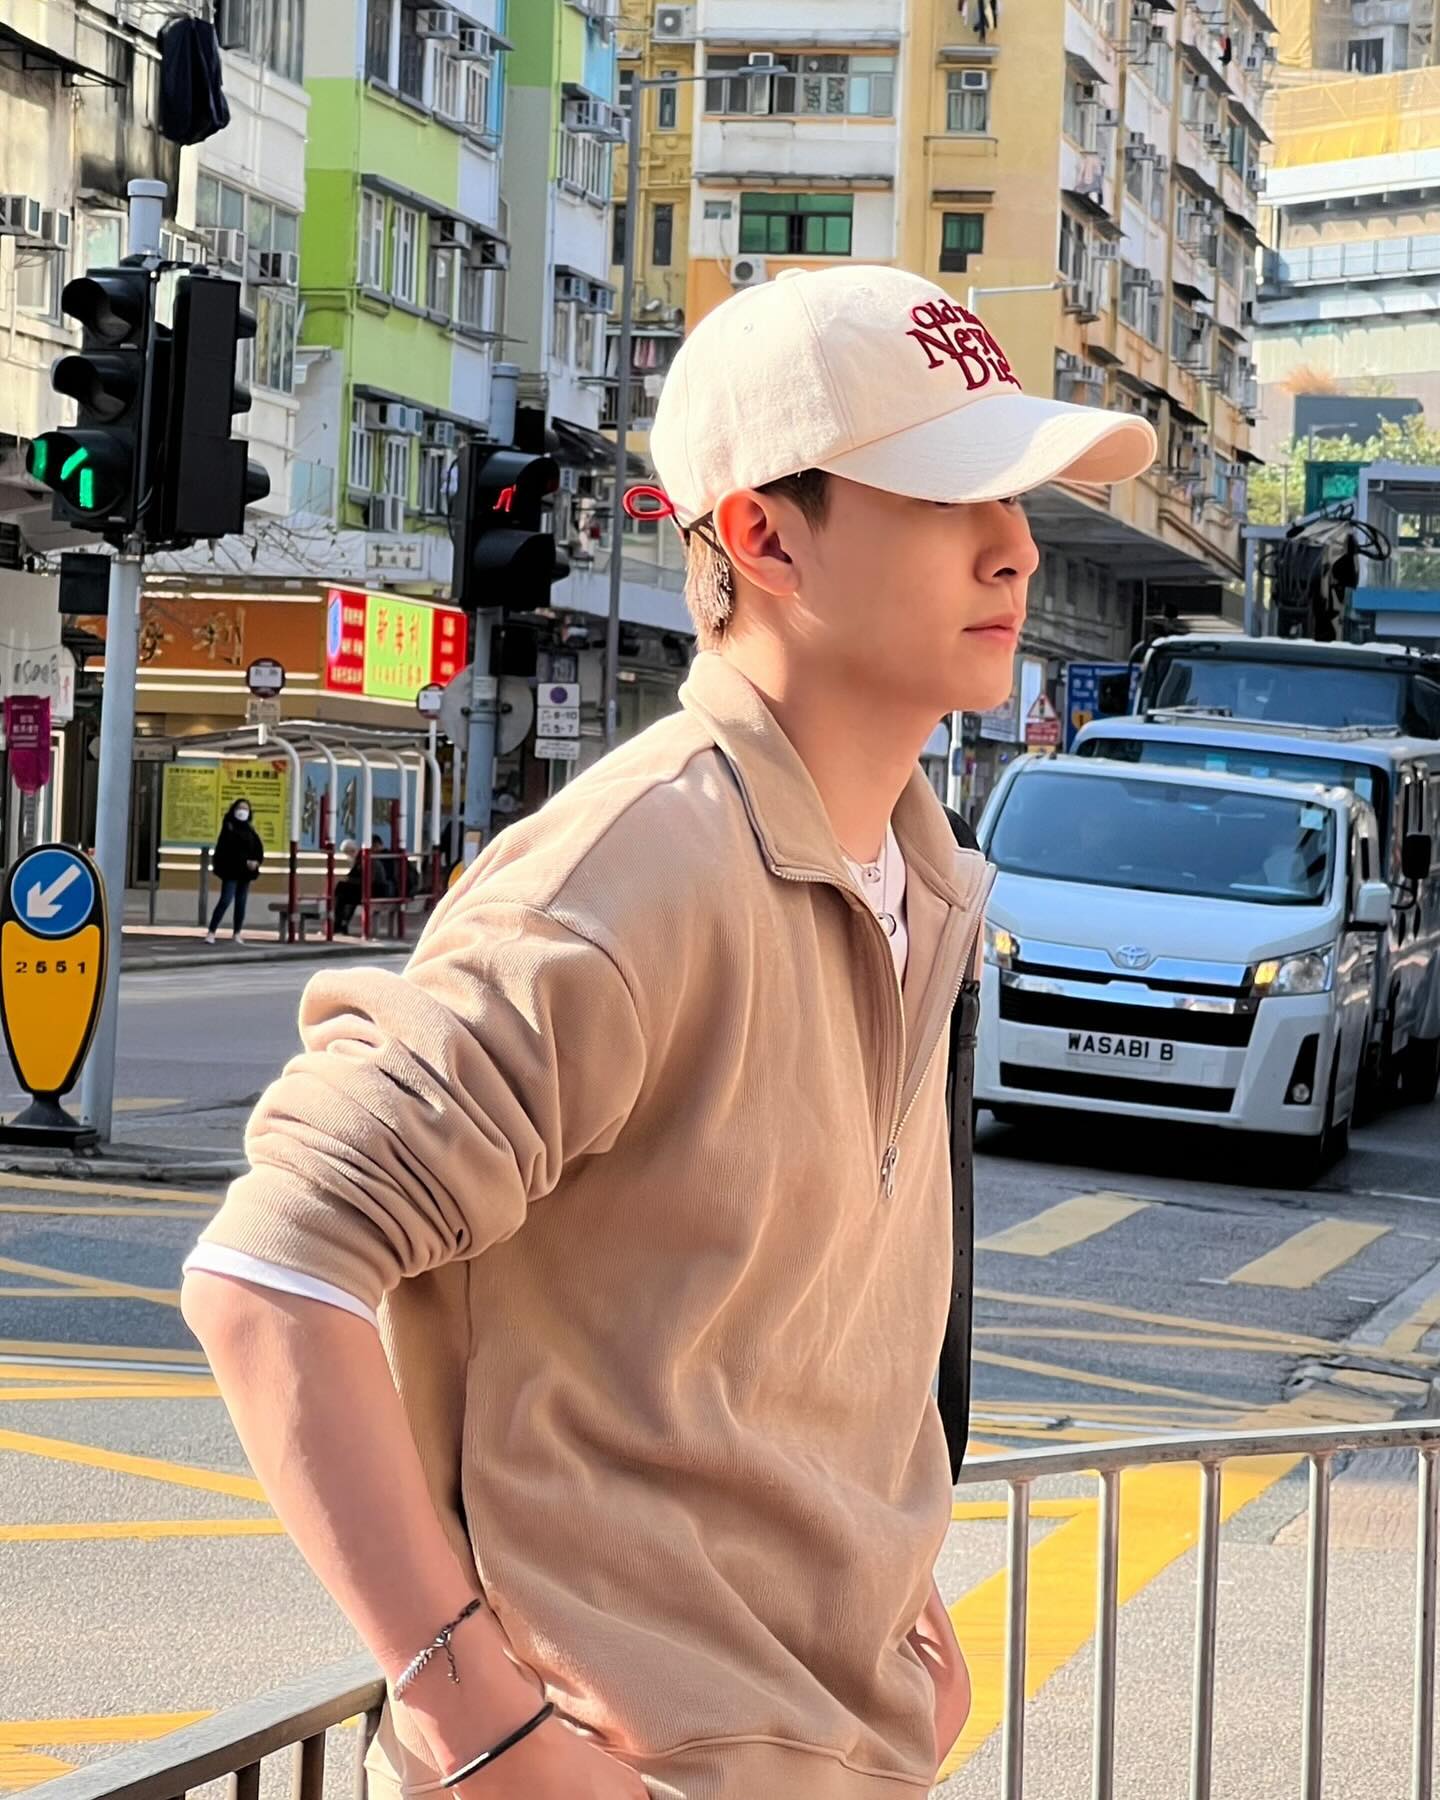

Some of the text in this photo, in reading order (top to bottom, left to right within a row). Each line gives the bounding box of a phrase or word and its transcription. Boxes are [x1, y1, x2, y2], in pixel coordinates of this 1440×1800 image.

[15, 960, 86, 975] 2551
[1068, 1032, 1175, 1062] WASABI B
